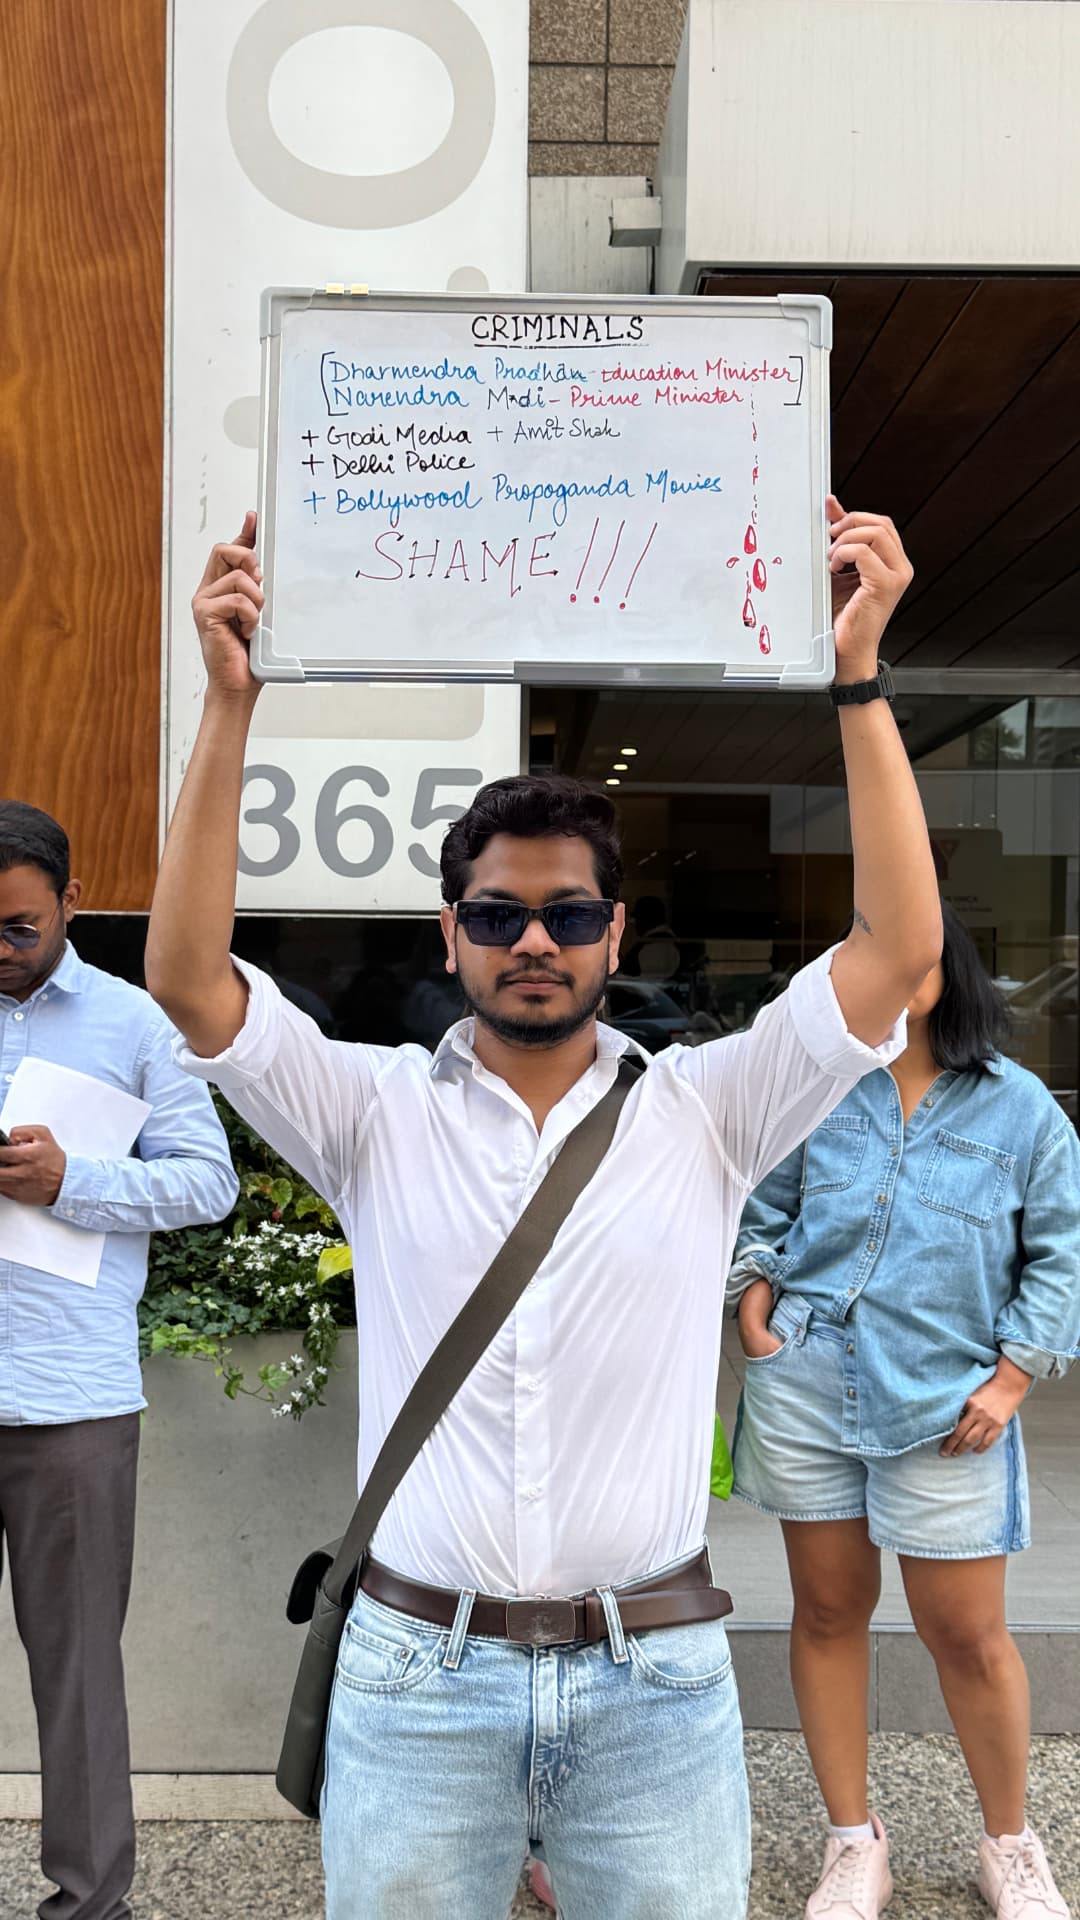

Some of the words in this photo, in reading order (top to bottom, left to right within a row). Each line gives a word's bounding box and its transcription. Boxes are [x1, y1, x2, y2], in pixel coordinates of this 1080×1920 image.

[472, 314, 644, 342] CRIMINALS
[333, 384, 470, 407] Narendra
[570, 385, 642, 408] Prime
[654, 386, 744, 407] Minister
[327, 423, 391, 450] Godi
[396, 422, 472, 451] Media
[513, 415, 565, 444] Amit
[332, 453, 395, 479] Delhi
[405, 450, 476, 473] Police
[336, 481, 483, 528] Bollywood
[492, 473, 636, 527] Propoganda
[645, 469, 723, 504] Movies
[236, 763, 485, 879] 365
